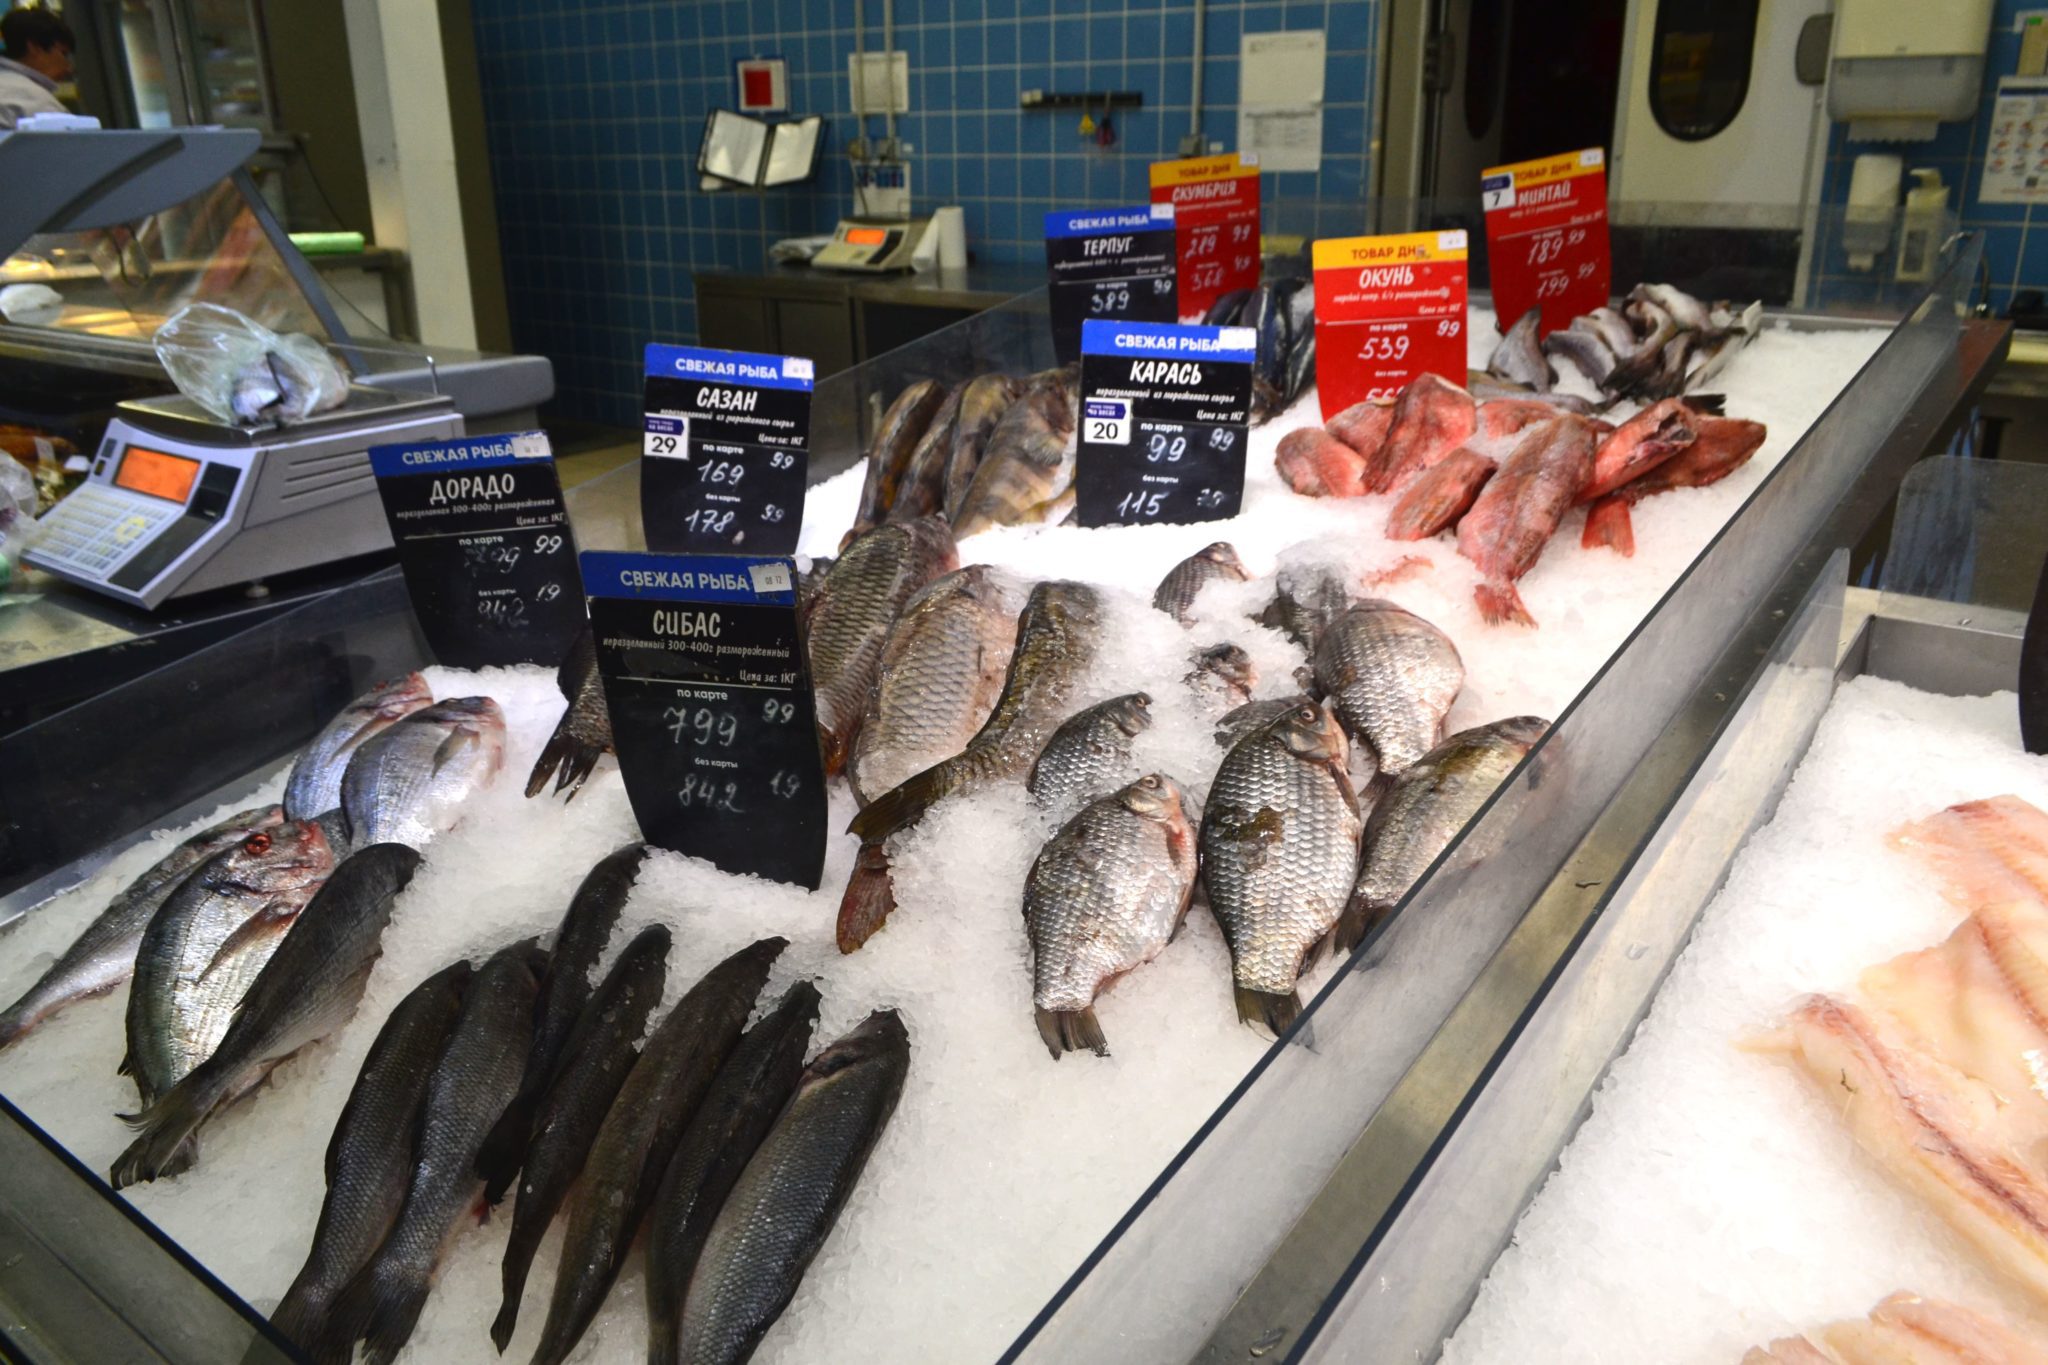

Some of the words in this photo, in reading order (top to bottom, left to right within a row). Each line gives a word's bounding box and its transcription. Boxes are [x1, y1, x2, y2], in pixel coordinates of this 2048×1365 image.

[1172, 180, 1237, 202] СКУМБРИЯ
[1493, 191, 1502, 206] 7
[1518, 179, 1572, 207] МИНТАЙ
[1068, 215, 1116, 231] СВЕЖАЯ
[1118, 213, 1149, 227] РЫБА
[1083, 236, 1134, 256] ТЕРПУГ
[1352, 246, 1394, 260] ТОВАР
[1527, 236, 1564, 266] 189
[1567, 228, 1586, 246] 99
[1359, 265, 1415, 289] ОКУНЬ
[1536, 275, 1569, 299] 199
[1090, 290, 1130, 313] 389
[1153, 279, 1172, 295] 99
[1115, 333, 1176, 350] СВЕЖАЯ
[1180, 337, 1221, 353] РЫБА
[1358, 335, 1410, 360] 539
[1436, 319, 1461, 338] 99
[675, 358, 736, 376] СВЕЖАЯ
[738, 364, 778, 380] РЫБА
[1129, 360, 1202, 386] КАРАСЬ
[696, 386, 758, 412] САЗАН
[1093, 422, 1119, 440] 20
[1141, 422, 1153, 431] по
[1155, 423, 1183, 434] карте
[402, 447, 468, 466] СВЕЖАЯ
[472, 443, 514, 460] РЫБА
[652, 435, 677, 454] 29
[703, 443, 715, 452] по
[717, 445, 745, 456] карте
[1147, 434, 1187, 463] 99
[1209, 427, 1235, 451] 99
[698, 459, 745, 485] 169
[770, 451, 795, 470] 99
[1142, 474, 1154, 482] без
[1156, 475, 1179, 484] карты
[429, 473, 515, 506] ДОРАДО
[705, 492, 715, 501] без
[716, 494, 741, 504] карты
[1117, 490, 1170, 517] 115
[516, 515, 535, 526] Цена
[684, 509, 736, 533] 178
[458, 537, 472, 547] по
[474, 535, 504, 546] карте
[533, 535, 562, 554] 99
[620, 570, 695, 590] СВЕЖАЯ
[698, 572, 750, 591] РЫБА
[653, 609, 721, 638] СИБАС
[603, 637, 665, 651] неразделанный
[668, 640, 714, 654] 300-400г
[716, 644, 790, 659] размороженный
[739, 669, 761, 683] Цена
[764, 673, 777, 683] за:
[781, 672, 796, 684] 1КГ
[677, 687, 695, 698] по
[698, 689, 728, 702] карте
[663, 706, 738, 747] 799
[761, 698, 795, 724] 99
[694, 757, 709, 768] без
[710, 758, 738, 770] карты
[678, 773, 745, 814] 842
[769, 770, 801, 799] 19
